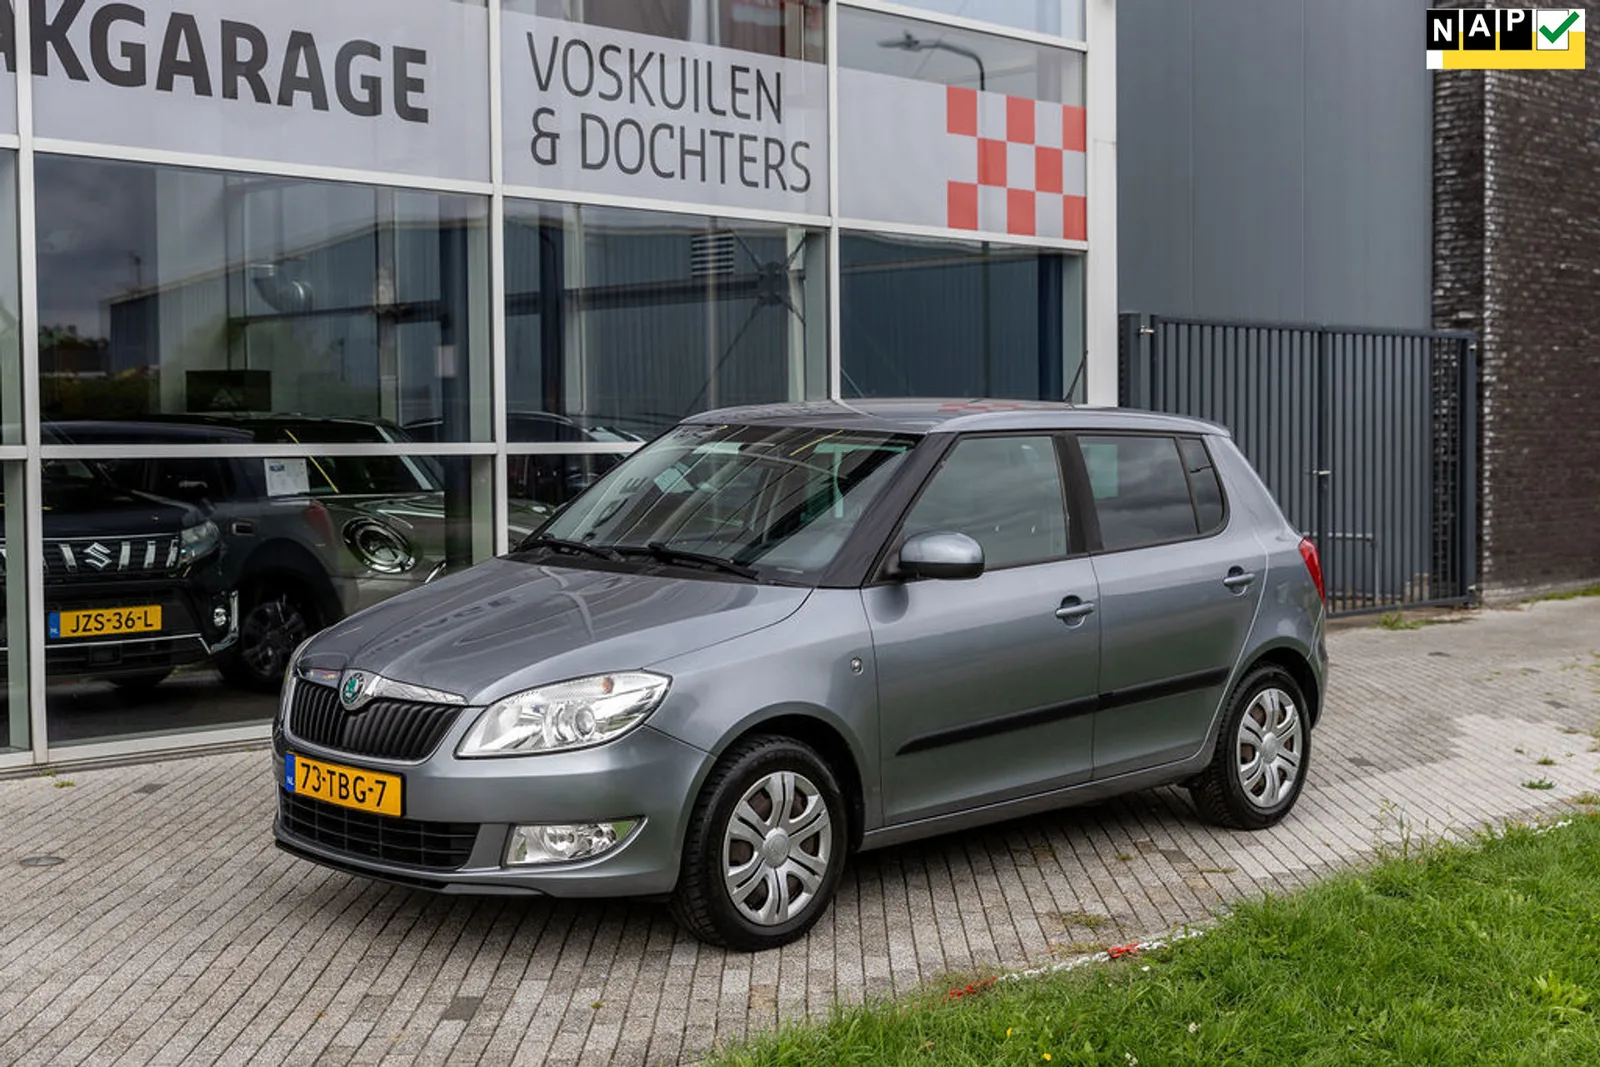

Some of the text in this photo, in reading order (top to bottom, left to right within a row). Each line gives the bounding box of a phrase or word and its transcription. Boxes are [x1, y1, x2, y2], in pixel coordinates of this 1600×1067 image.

[526, 31, 782, 124] VOSKUILEN
[531, 107, 811, 193] & DOCHTERS
[70, 609, 154, 634] JZS-36-L
[301, 762, 387, 807] 73-TBG-7
